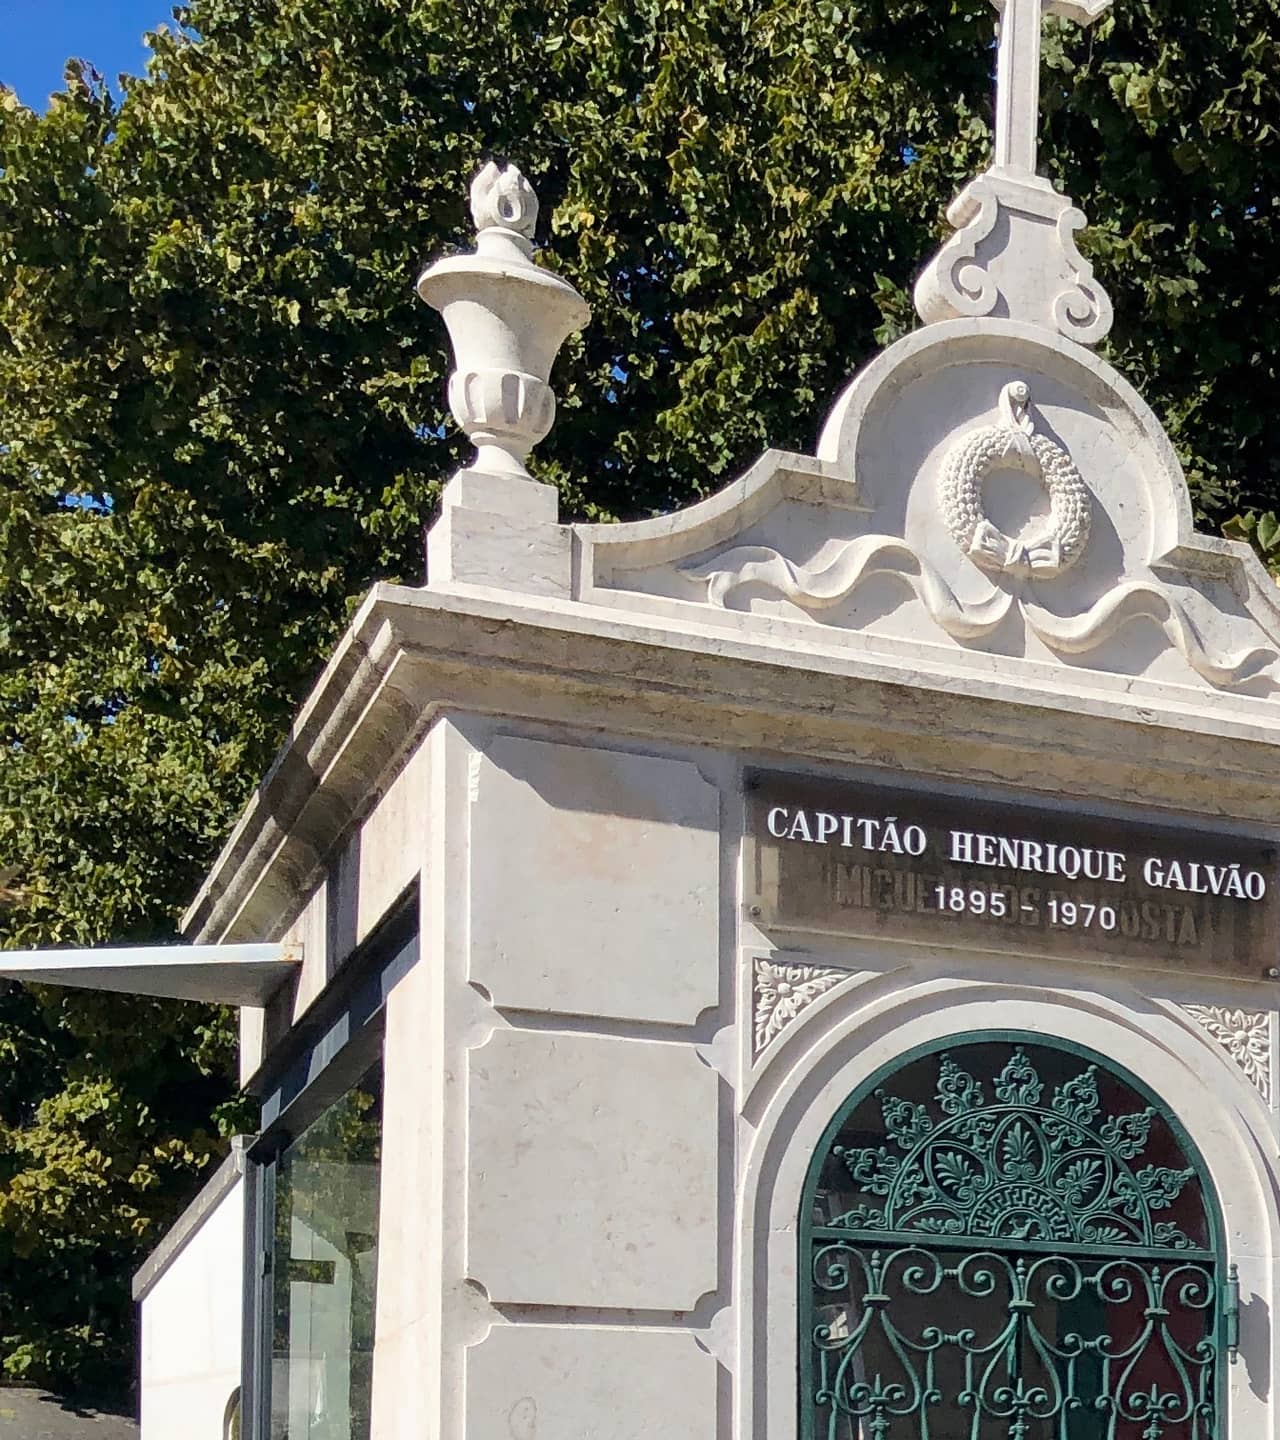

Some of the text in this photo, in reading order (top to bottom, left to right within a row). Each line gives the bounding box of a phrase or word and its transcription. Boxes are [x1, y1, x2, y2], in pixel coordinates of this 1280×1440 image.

[767, 807, 1266, 901] CAPITÃO HENRIQUE GALVÃO
[935, 886, 1006, 917] 1895
[1048, 902, 1117, 931] 1970
